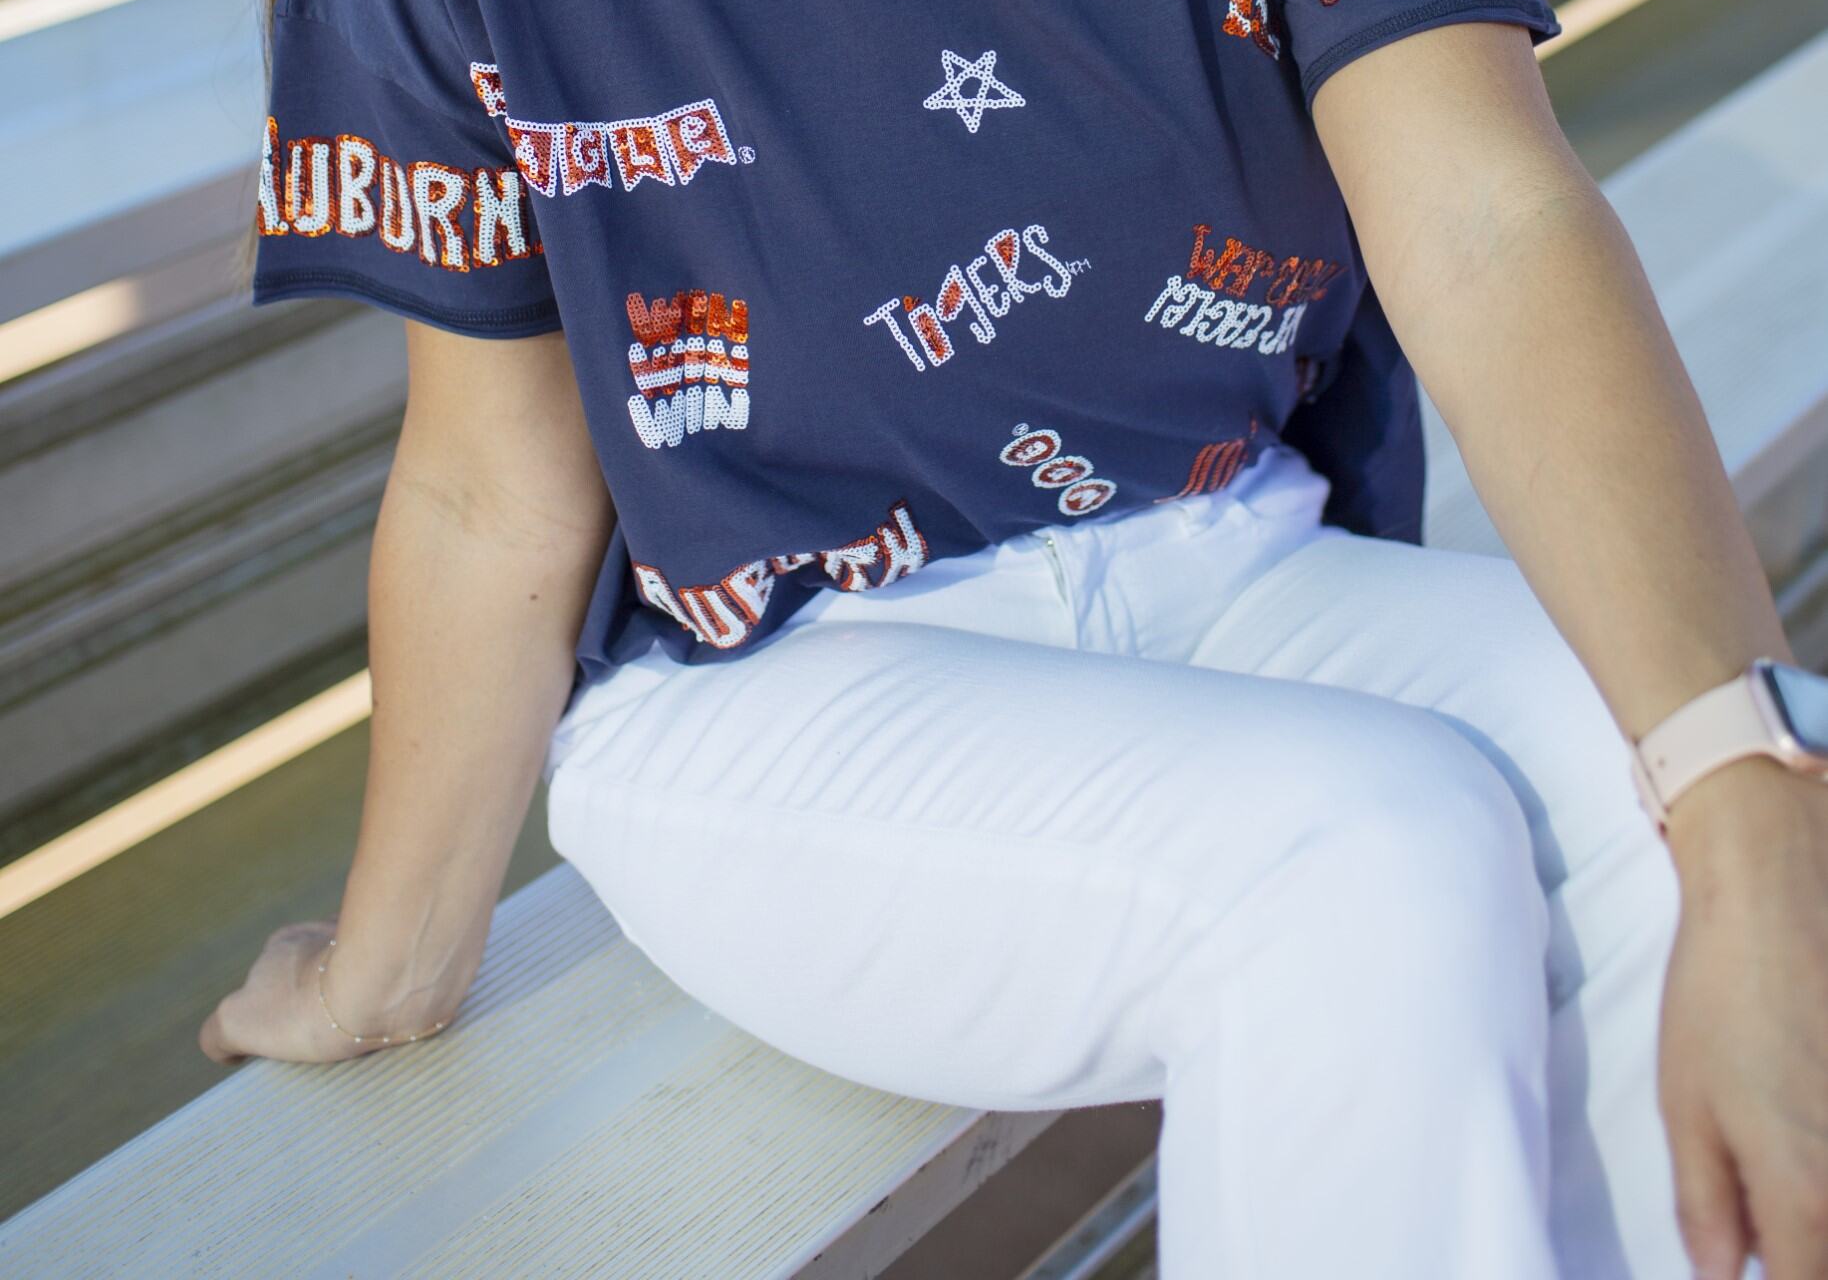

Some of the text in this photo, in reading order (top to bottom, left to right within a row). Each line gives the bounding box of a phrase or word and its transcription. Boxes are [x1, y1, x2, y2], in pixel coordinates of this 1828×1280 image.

[625, 288, 749, 348] WIN
[627, 335, 750, 399] WIN
[626, 384, 751, 450] WIN
